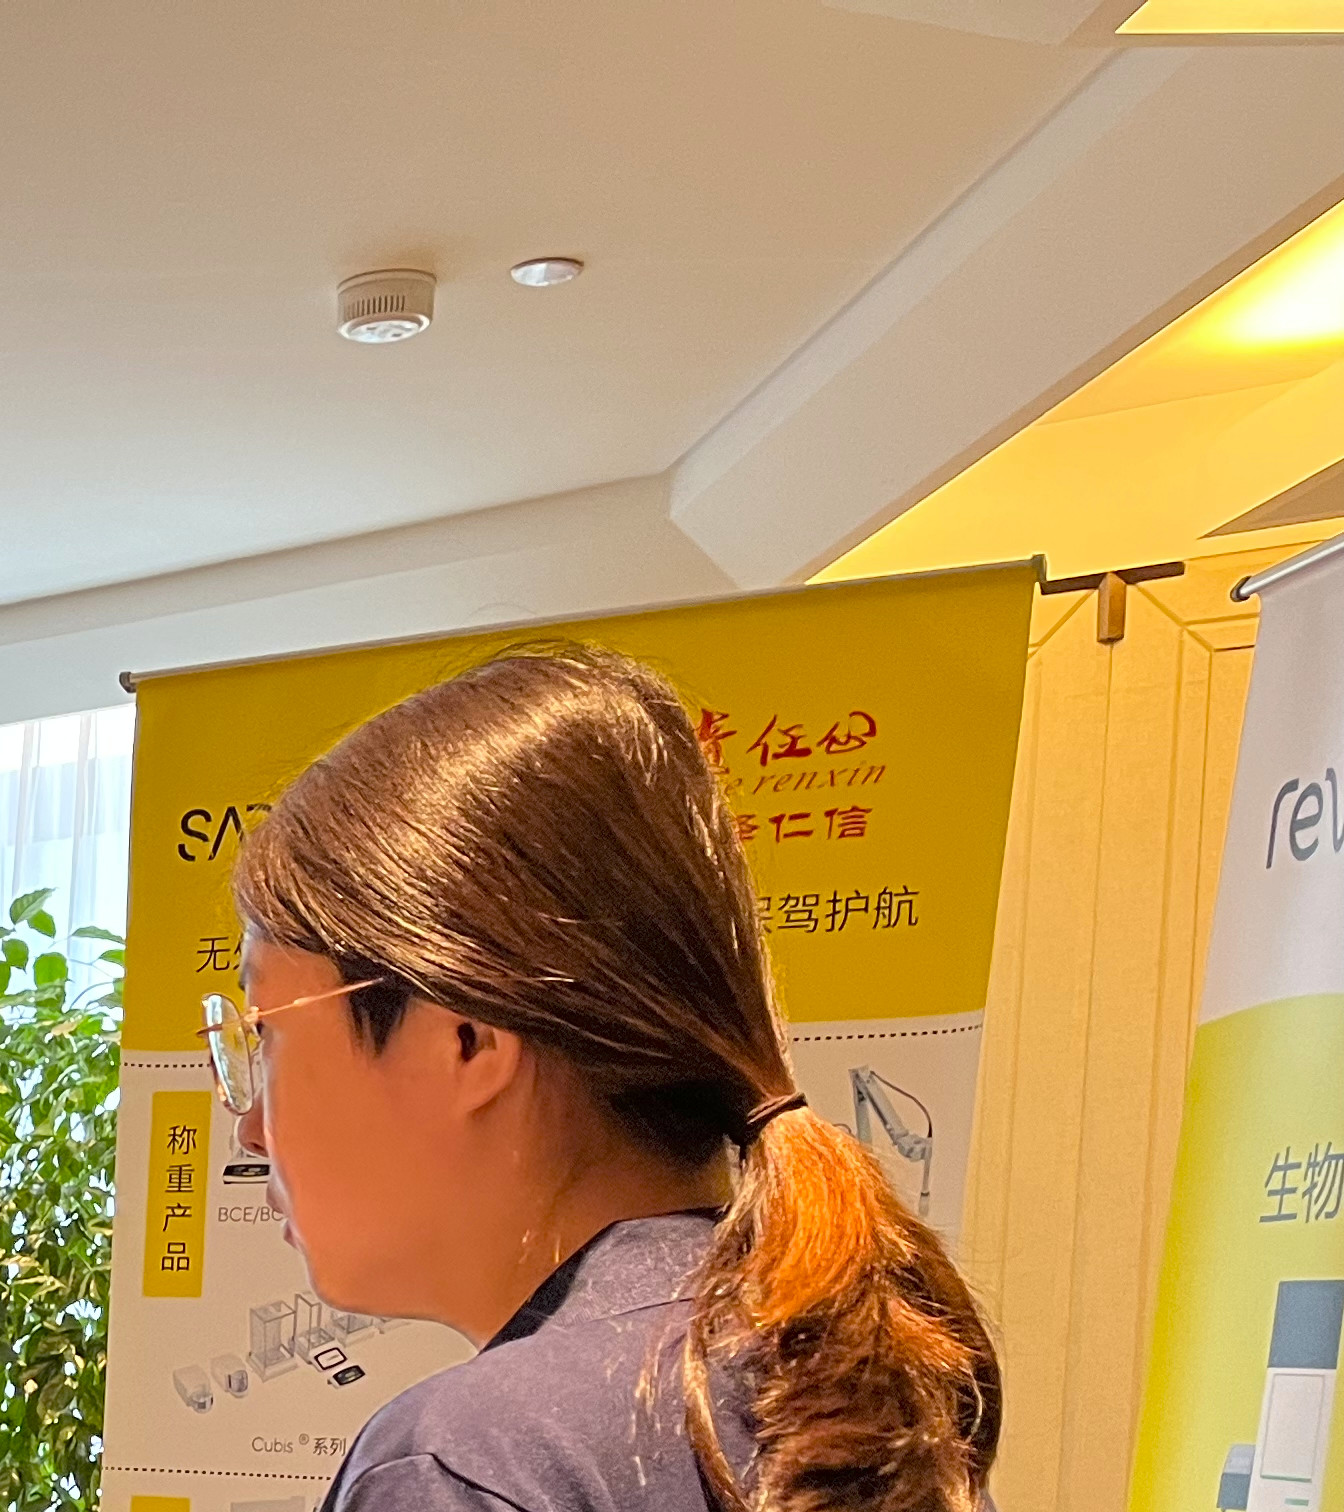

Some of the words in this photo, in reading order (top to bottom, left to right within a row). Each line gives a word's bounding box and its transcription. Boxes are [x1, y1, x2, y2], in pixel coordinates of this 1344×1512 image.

[160, 1124, 198, 1272] 称重产品
[313, 1437, 347, 1457] 系列
